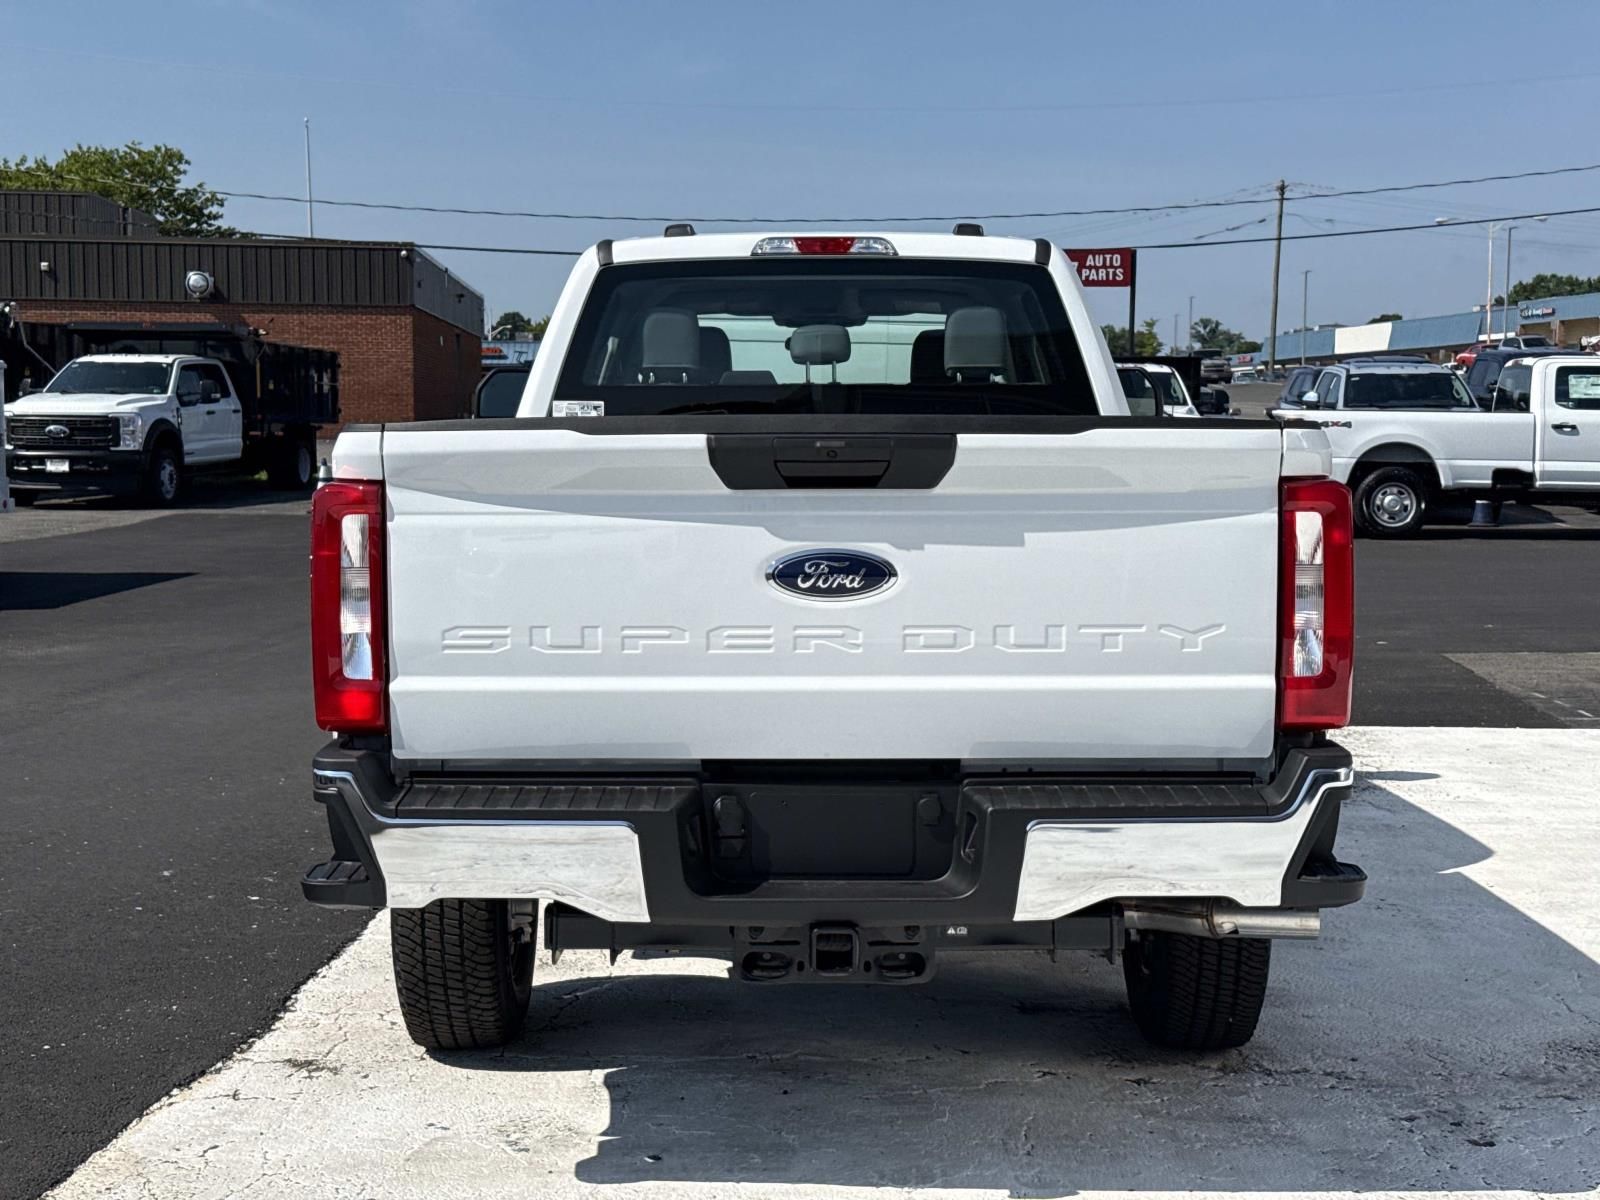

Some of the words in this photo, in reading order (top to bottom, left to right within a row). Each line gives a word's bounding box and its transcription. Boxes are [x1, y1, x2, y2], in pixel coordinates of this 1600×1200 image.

[1085, 254, 1121, 267] AUTO
[1081, 268, 1124, 281] PARTS
[797, 560, 866, 588] Ford
[441, 625, 863, 654] SUPER
[903, 624, 1226, 653] DUTY
